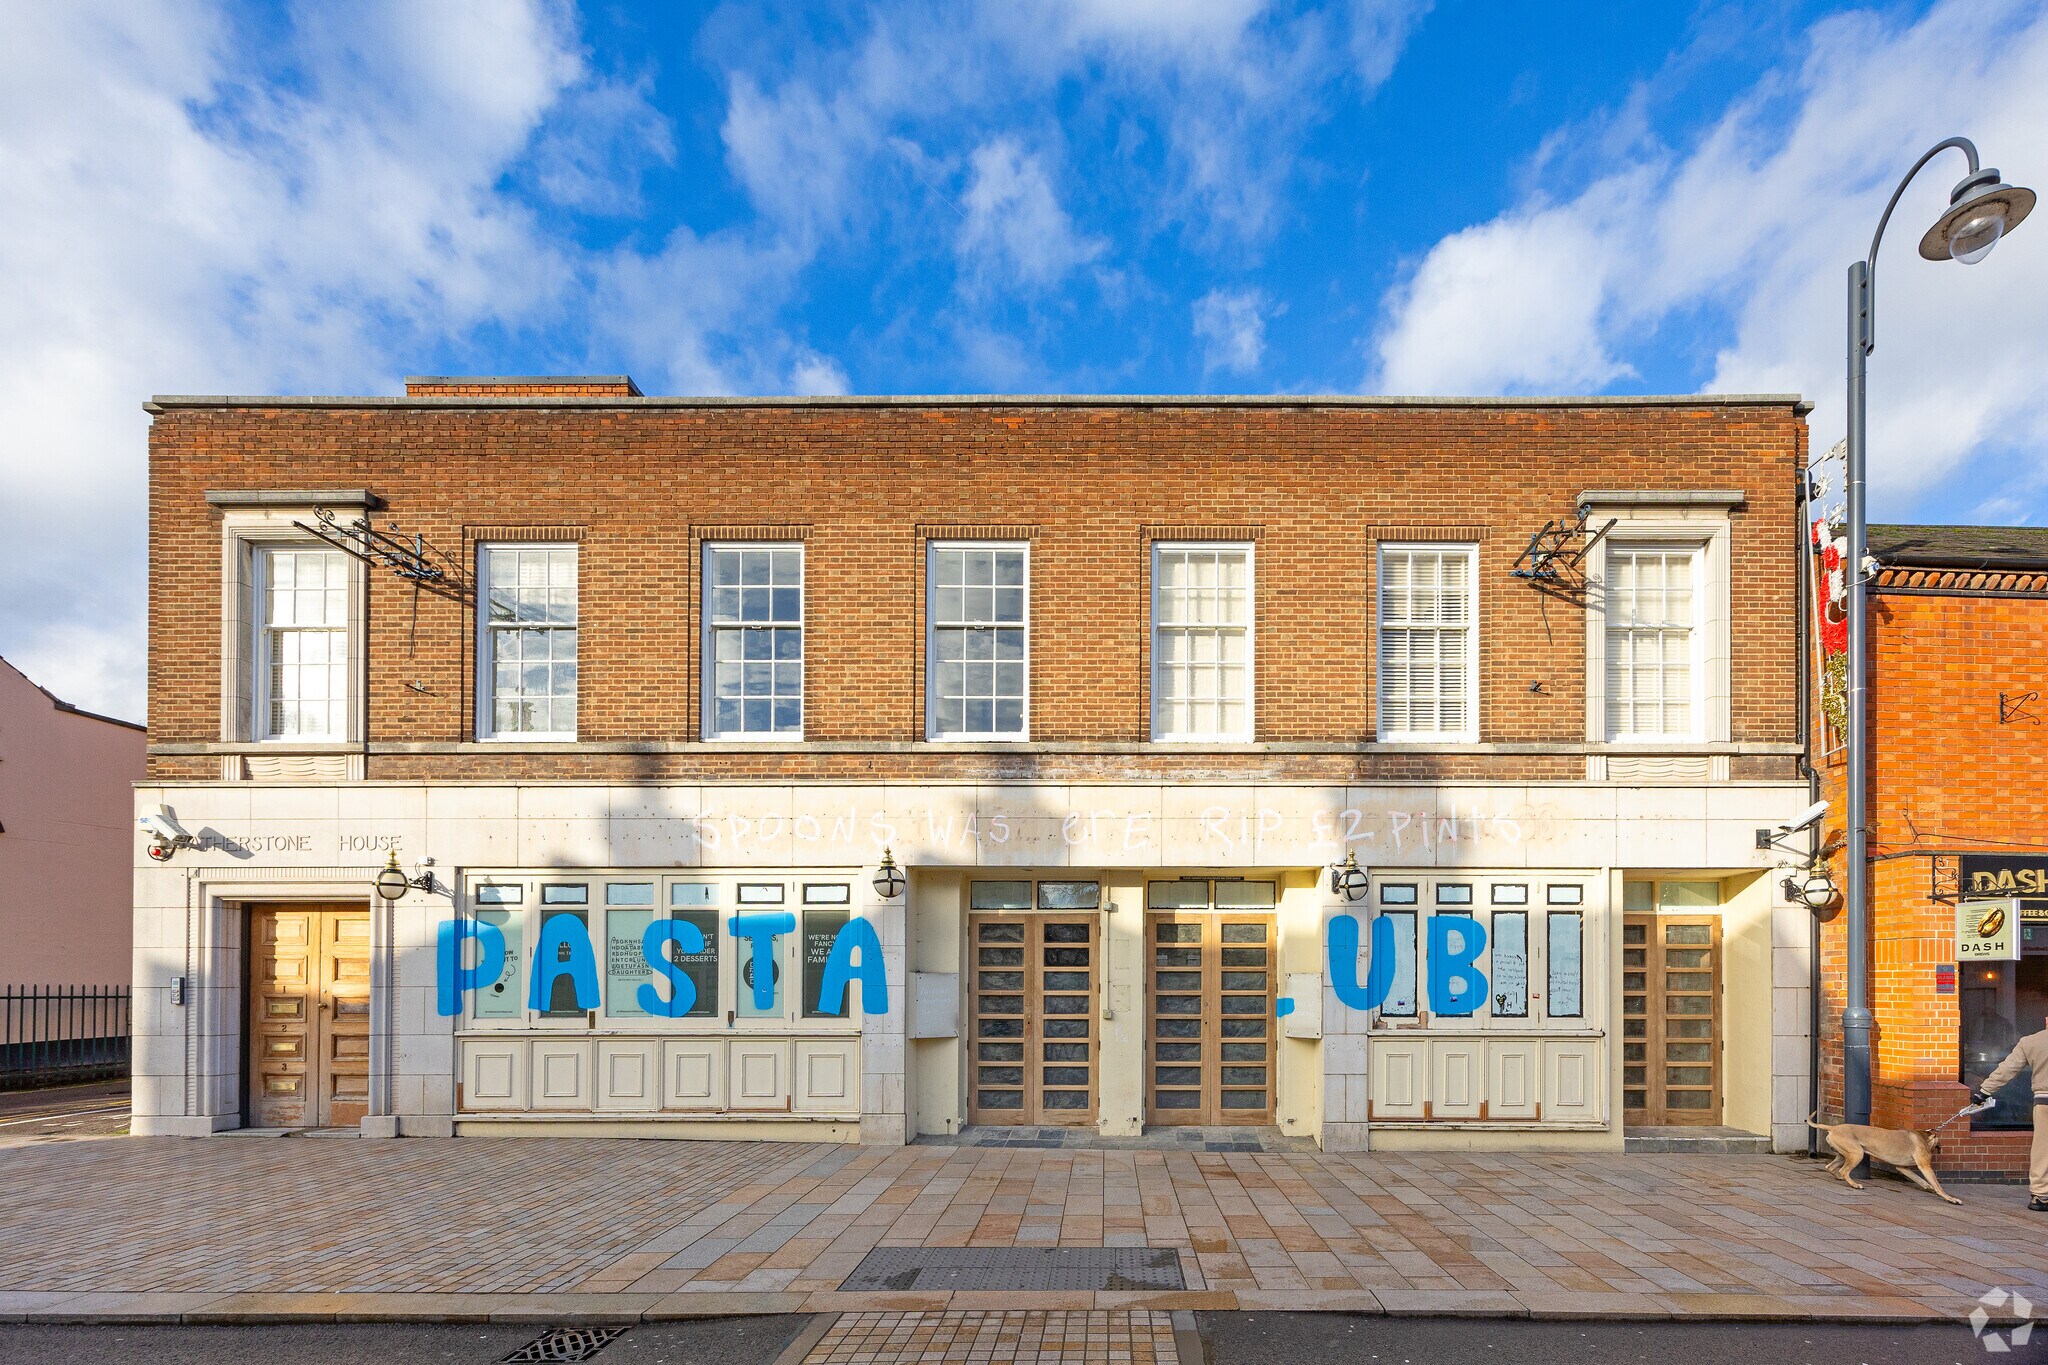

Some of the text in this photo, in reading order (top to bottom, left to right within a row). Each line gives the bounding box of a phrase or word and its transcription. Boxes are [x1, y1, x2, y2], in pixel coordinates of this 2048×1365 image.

[690, 806, 898, 851] SPOONS
[928, 808, 1012, 847] WAS
[340, 834, 403, 852] HOUSE
[1961, 942, 2005, 952] DASH
[436, 912, 889, 1017] PASTA
[1276, 914, 1489, 1015] UB
[281, 1024, 287, 1032] 2
[281, 1062, 288, 1071] 3
